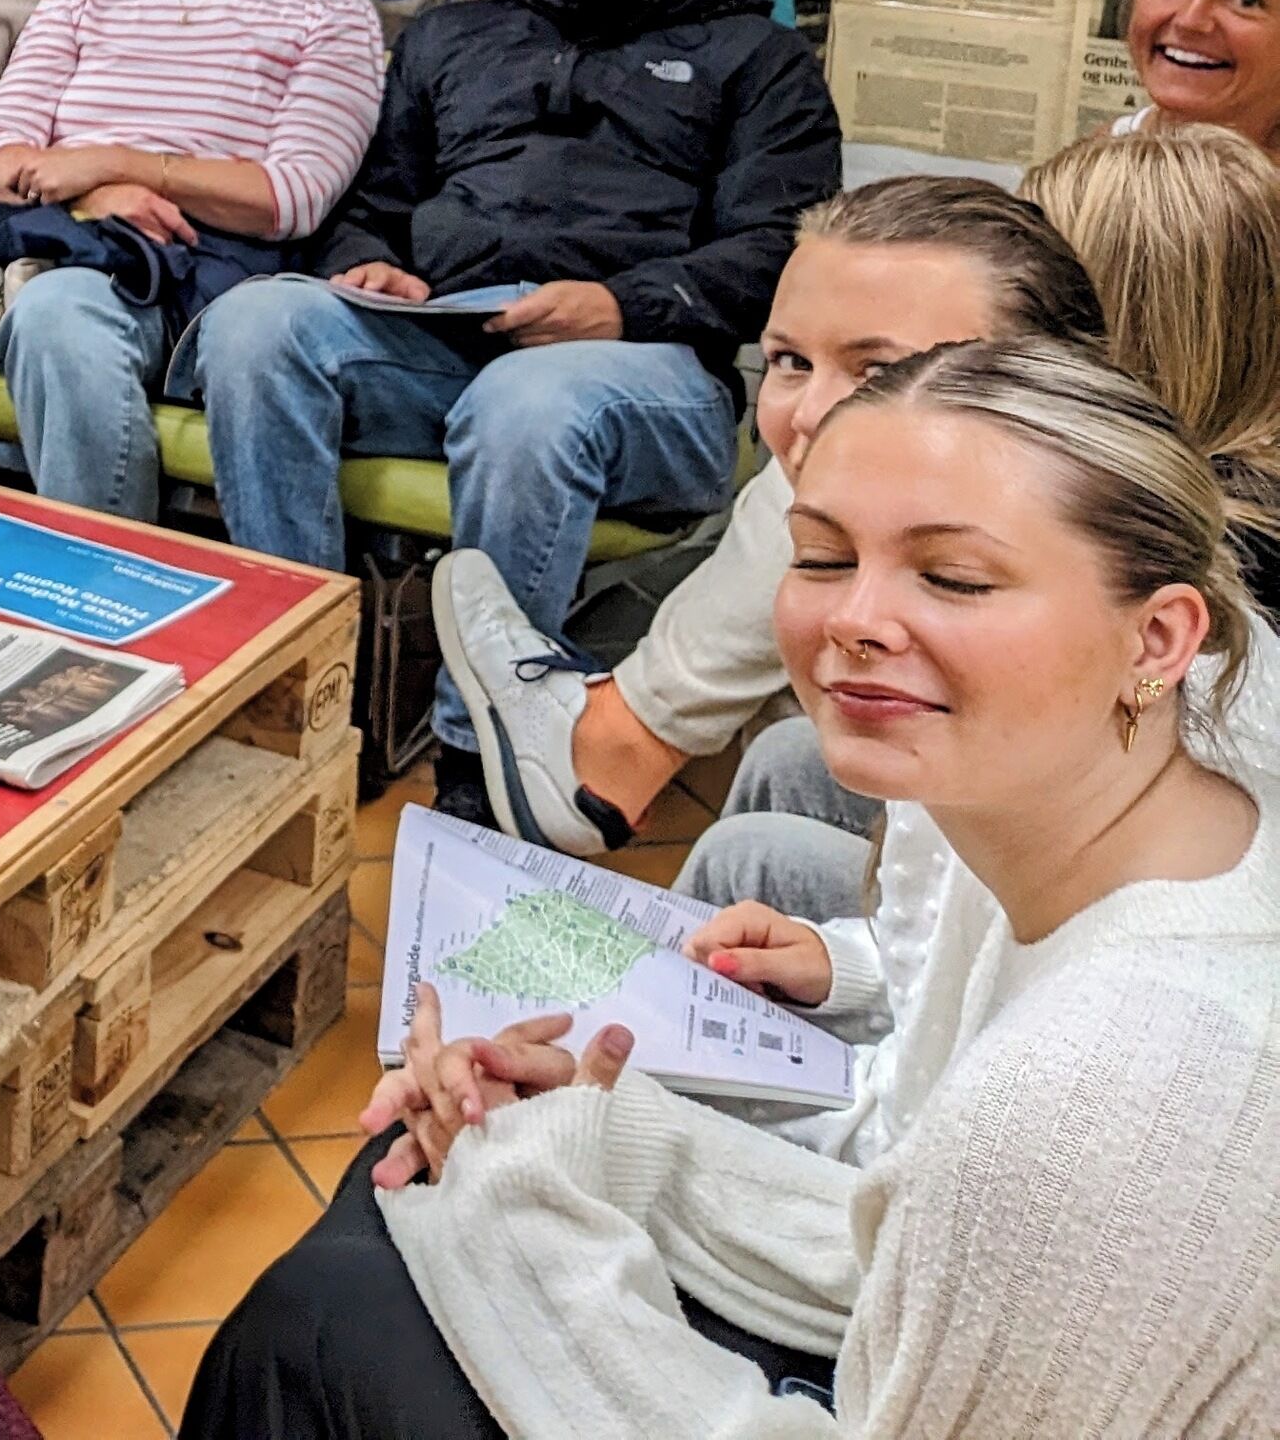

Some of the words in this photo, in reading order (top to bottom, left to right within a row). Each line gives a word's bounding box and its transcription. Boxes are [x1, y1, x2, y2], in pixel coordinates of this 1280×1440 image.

[1082, 71, 1101, 85] og
[5, 580, 80, 609] Modern
[13, 572, 78, 596] Rooms
[81, 591, 149, 620] Private
[401, 941, 423, 1028] Kulturguide
